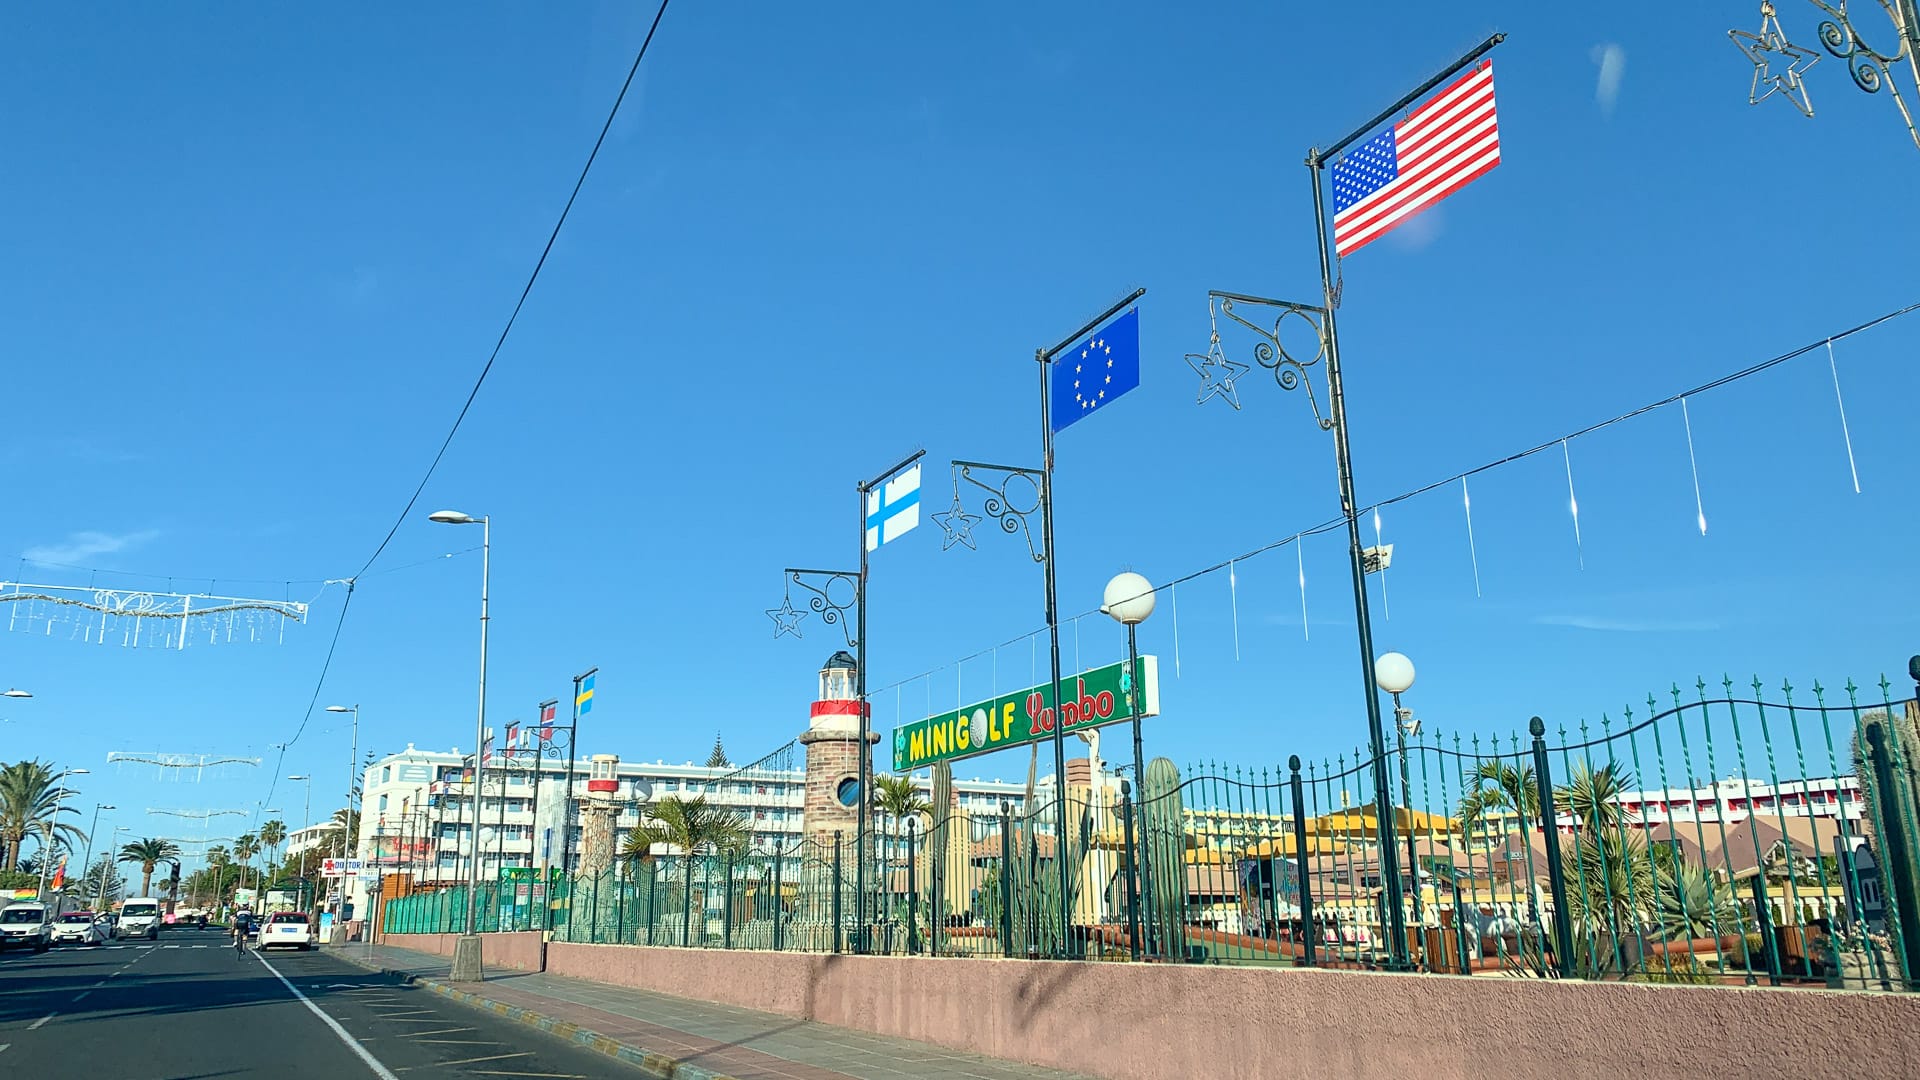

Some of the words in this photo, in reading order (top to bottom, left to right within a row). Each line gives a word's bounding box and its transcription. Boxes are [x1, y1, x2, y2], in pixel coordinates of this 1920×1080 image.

[910, 703, 1015, 761] MINIGOLF
[1026, 679, 1114, 735] Yumbo
[335, 861, 361, 869] DOTOR
